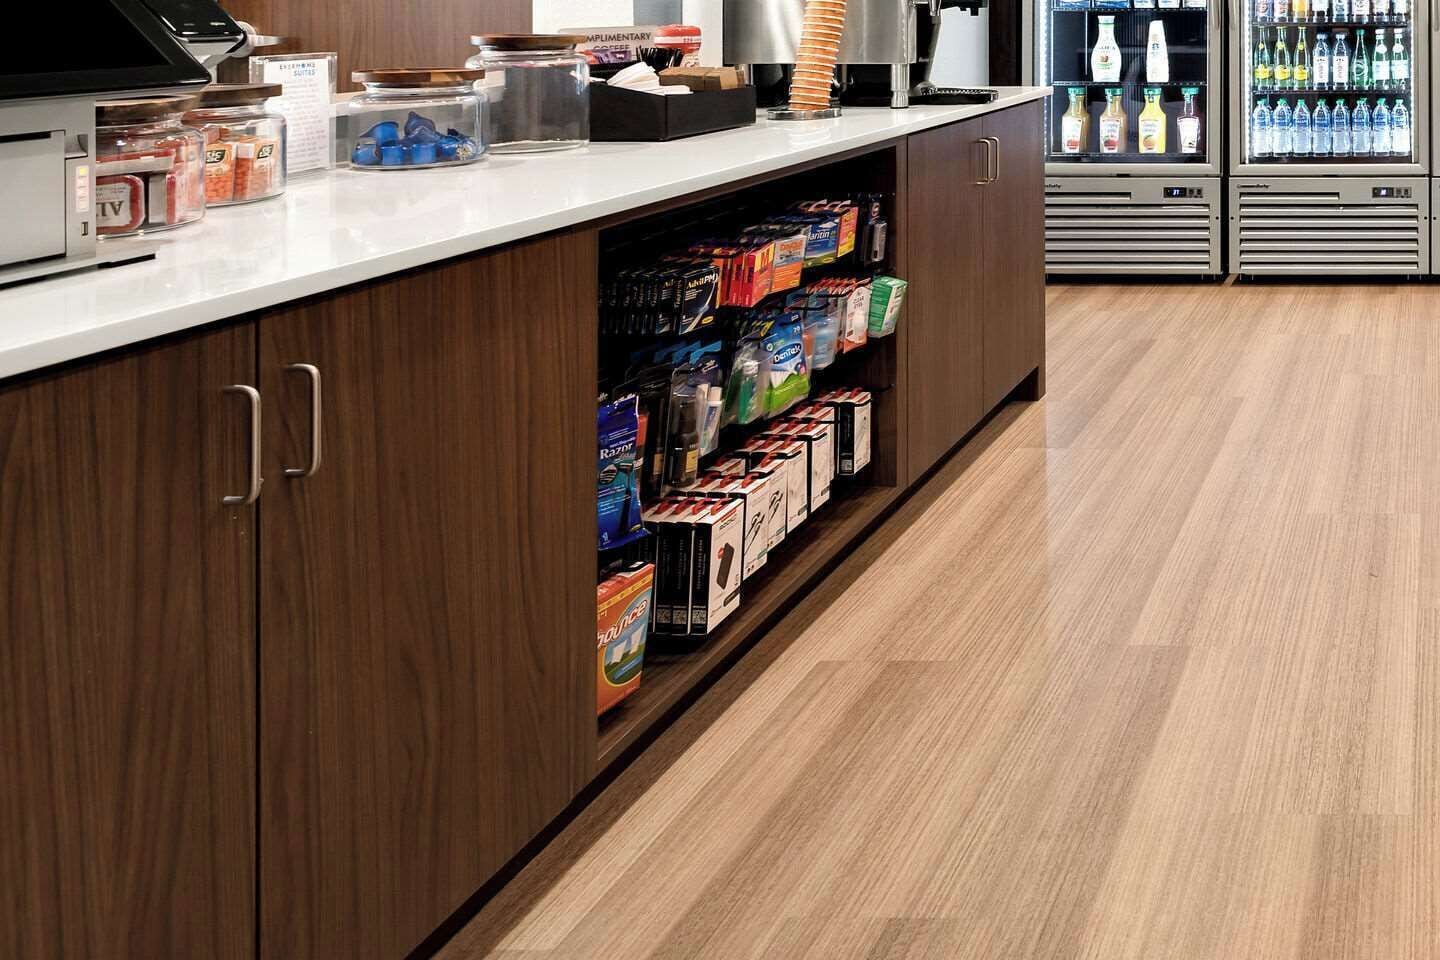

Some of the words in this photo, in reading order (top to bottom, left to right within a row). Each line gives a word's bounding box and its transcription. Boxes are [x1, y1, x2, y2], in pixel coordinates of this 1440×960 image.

[586, 32, 651, 42] MPLIMENTARY
[808, 231, 830, 241] laritin
[774, 344, 801, 364] DenTek
[600, 443, 633, 460] Razor
